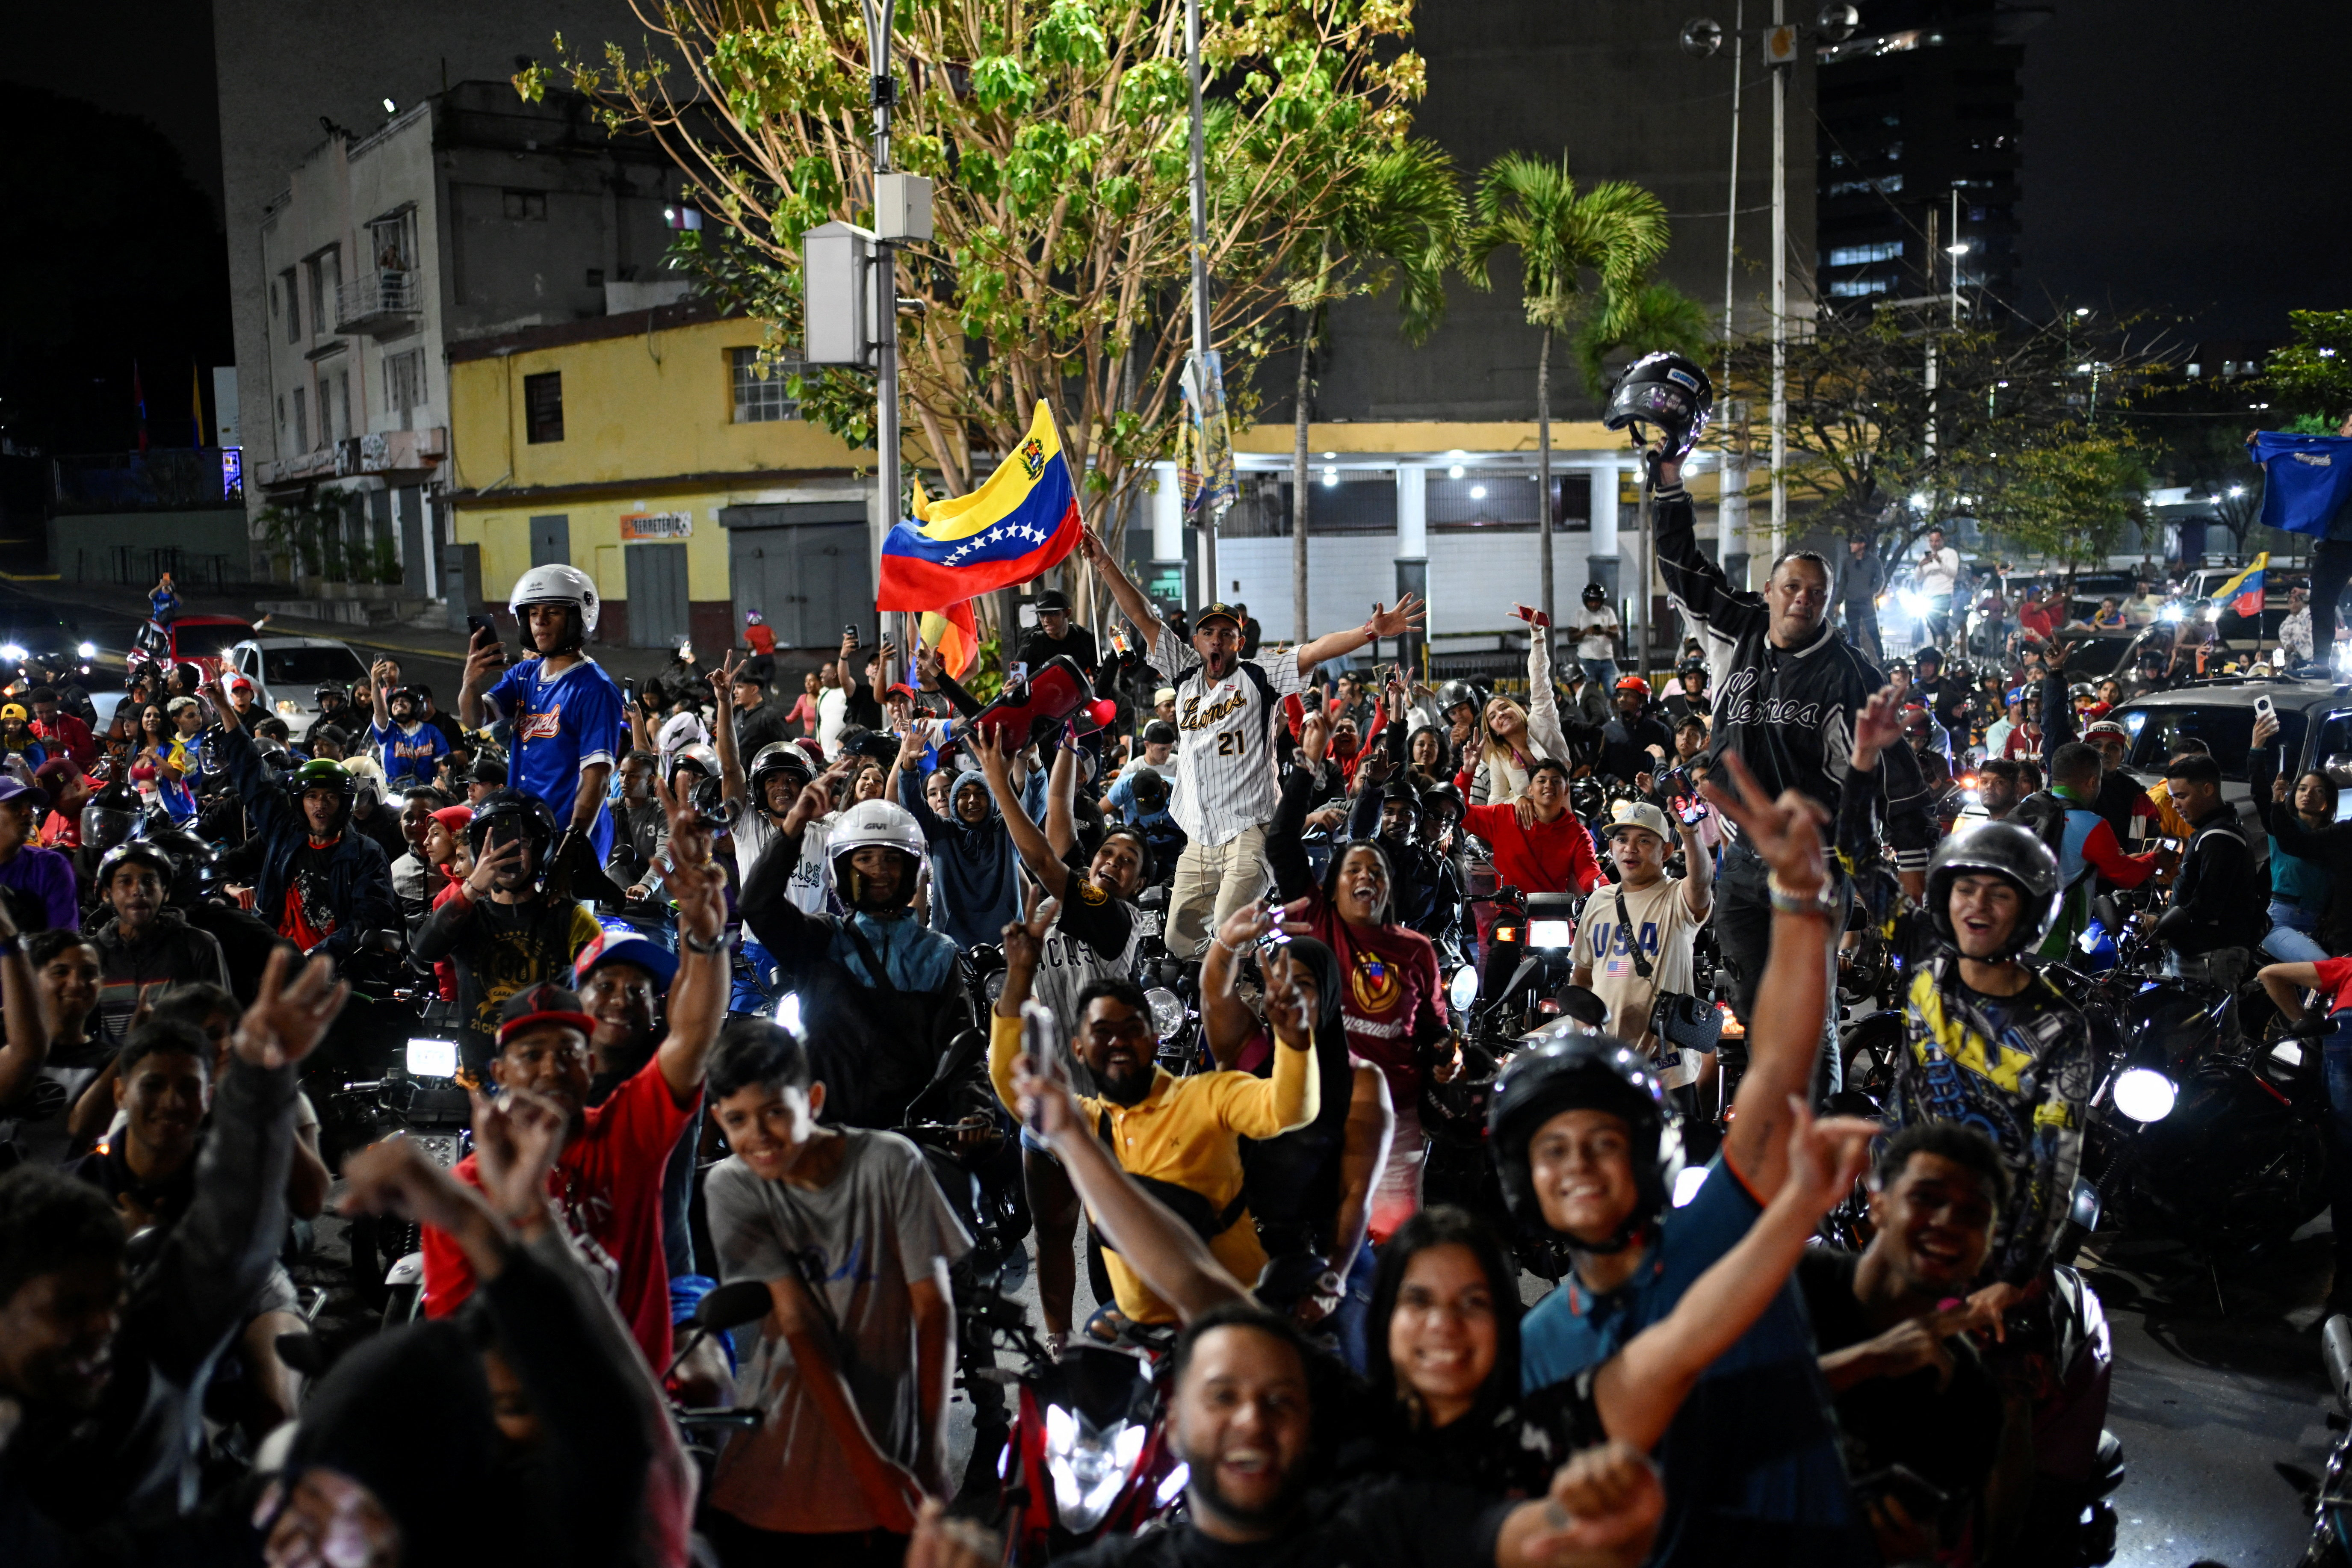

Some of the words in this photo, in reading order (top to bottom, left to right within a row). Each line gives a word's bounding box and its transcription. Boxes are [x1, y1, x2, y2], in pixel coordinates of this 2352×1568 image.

[1179, 690, 1247, 731] Leones
[1727, 667, 1820, 729] Leones
[514, 699, 560, 742] ezuela
[1218, 729, 1244, 756] 21
[647, 824, 656, 837] 3
[1593, 922, 1658, 958] USA
[1340, 1005, 1403, 1039] nezuela
[1655, 1056, 1676, 1069] USA
